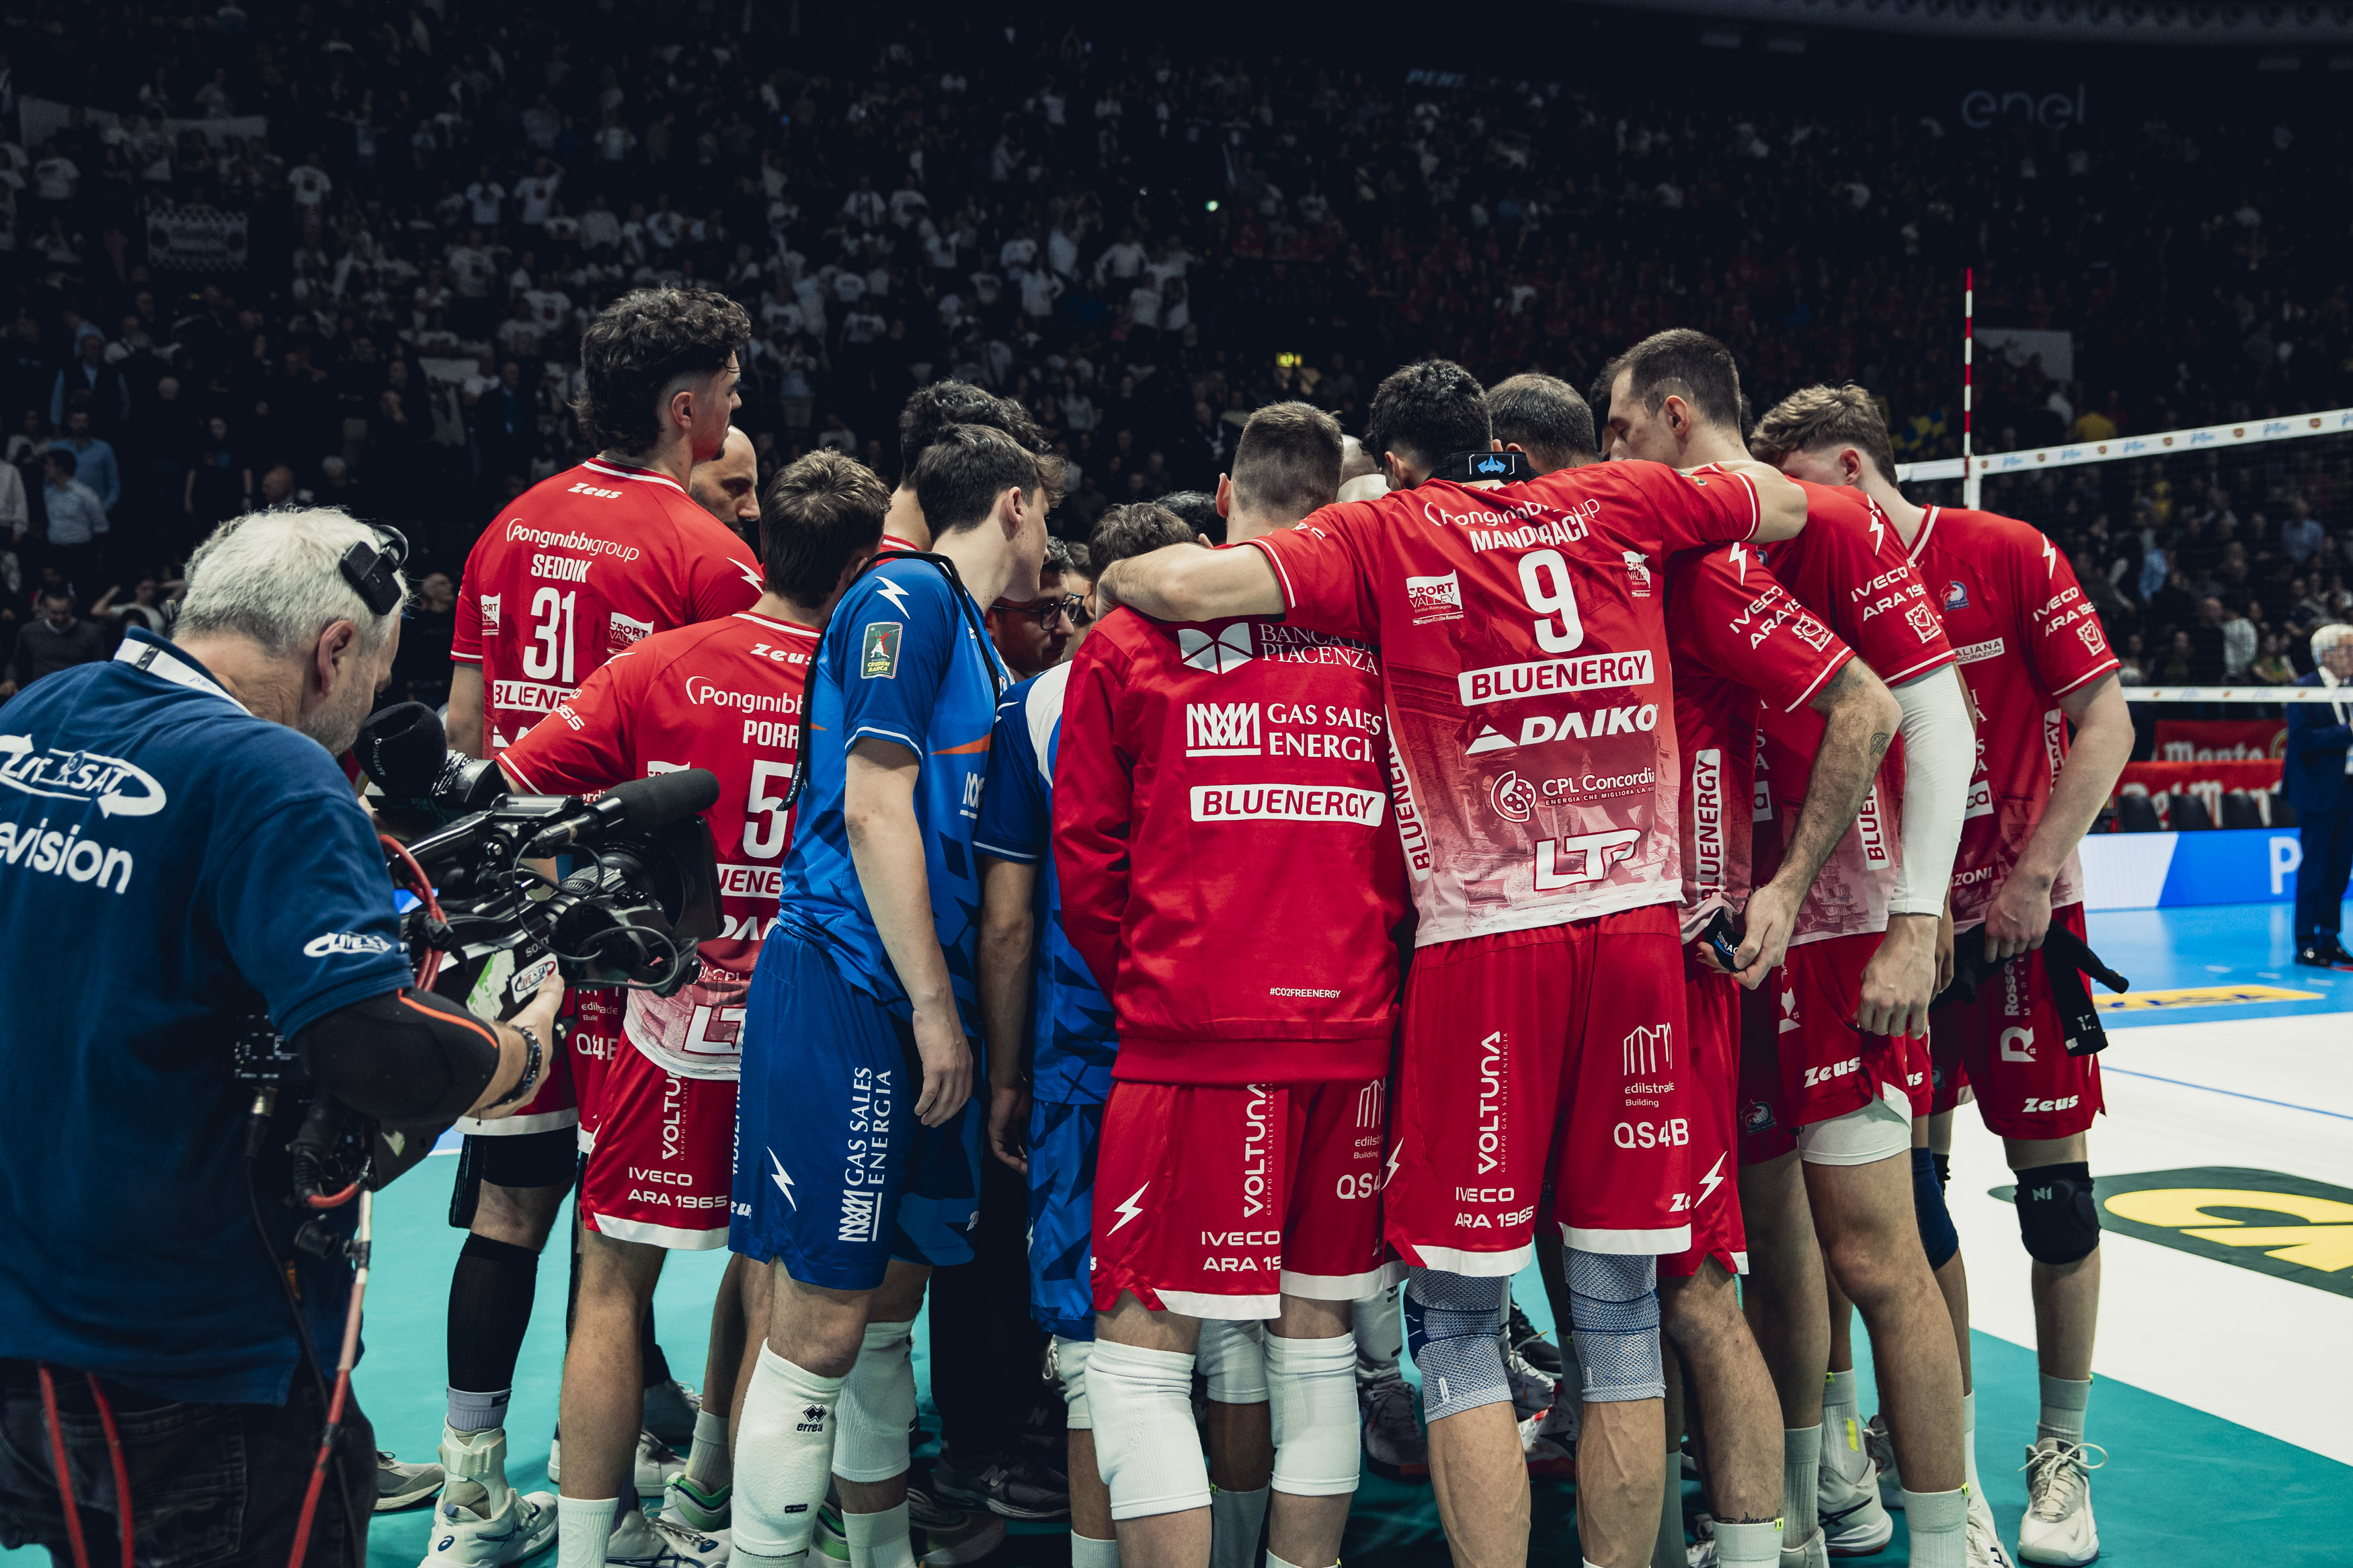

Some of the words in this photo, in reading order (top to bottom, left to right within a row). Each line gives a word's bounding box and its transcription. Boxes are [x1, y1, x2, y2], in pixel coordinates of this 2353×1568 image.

[1961, 82, 2085, 129] enel
[567, 483, 623, 499] Zeus
[531, 554, 592, 583] SEDDIK
[1408, 582, 1453, 598] SPORT
[1851, 565, 1909, 603] IVECO
[482, 604, 497, 612] ORT
[1410, 593, 1455, 608] VALLEY
[1518, 549, 1583, 653] 9
[1729, 585, 1784, 634] IVECO
[1863, 593, 1907, 622] ARA
[2033, 587, 2079, 622] IVECO
[523, 587, 575, 683] 31
[609, 630, 641, 645] VALLE
[610, 622, 648, 638] SPORT
[1750, 610, 1790, 650] ARA
[2045, 610, 2079, 637] ARA
[1261, 643, 1379, 675] PIACENZA
[1956, 641, 2001, 656] ALIANA
[1472, 655, 1646, 700] BLUENERGY
[495, 685, 571, 710] BLUENE
[1267, 703, 1317, 726] GAS
[1326, 706, 1382, 735] SALES
[1519, 706, 1657, 746] DAIKO
[743, 720, 799, 749] PORR
[1269, 732, 1375, 763] ENERGI
[373, 738, 387, 776] ARTENGO
[69, 764, 133, 794] SAT
[1542, 778, 1579, 796] CPL
[743, 759, 793, 859] 5
[1202, 790, 1375, 819] BLUENERGY
[1546, 796, 1580, 806] ENERGIA
[1583, 793, 1597, 801] CHE
[1601, 789, 1634, 798] MIGLIORA
[1697, 759, 1721, 901] BLUENERGY
[0, 818, 133, 895] evision
[520, 974, 532, 989] LIVE
[1269, 987, 1341, 998] #CO2FREENERGY
[1804, 1057, 1861, 1088] Zeus
[850, 1067, 872, 1132] SALES
[1478, 1031, 1501, 1175] VOLTUNA
[1626, 1099, 1659, 1108] Building
[2022, 1095, 2079, 1112] Zeus
[662, 1071, 681, 1159] VOLTU
[868, 1070, 891, 1184] ENERGIA
[1613, 1118, 1689, 1149] QS4B
[845, 1139, 867, 1186] GAS
[1353, 1150, 1378, 1159] Building
[629, 1167, 692, 1186] IVECO
[1337, 1172, 1382, 1200] QS4
[628, 1189, 671, 1206] ARA
[676, 1195, 727, 1208] 1965
[1455, 1187, 1515, 1202] IVECO
[1669, 1192, 1691, 1212] Ze
[1455, 1212, 1492, 1229] ARA
[1497, 1206, 1534, 1227] 1965
[1201, 1231, 1280, 1246] IVECO
[1203, 1256, 1258, 1272] ARA
[1264, 1255, 1281, 1270] 19
